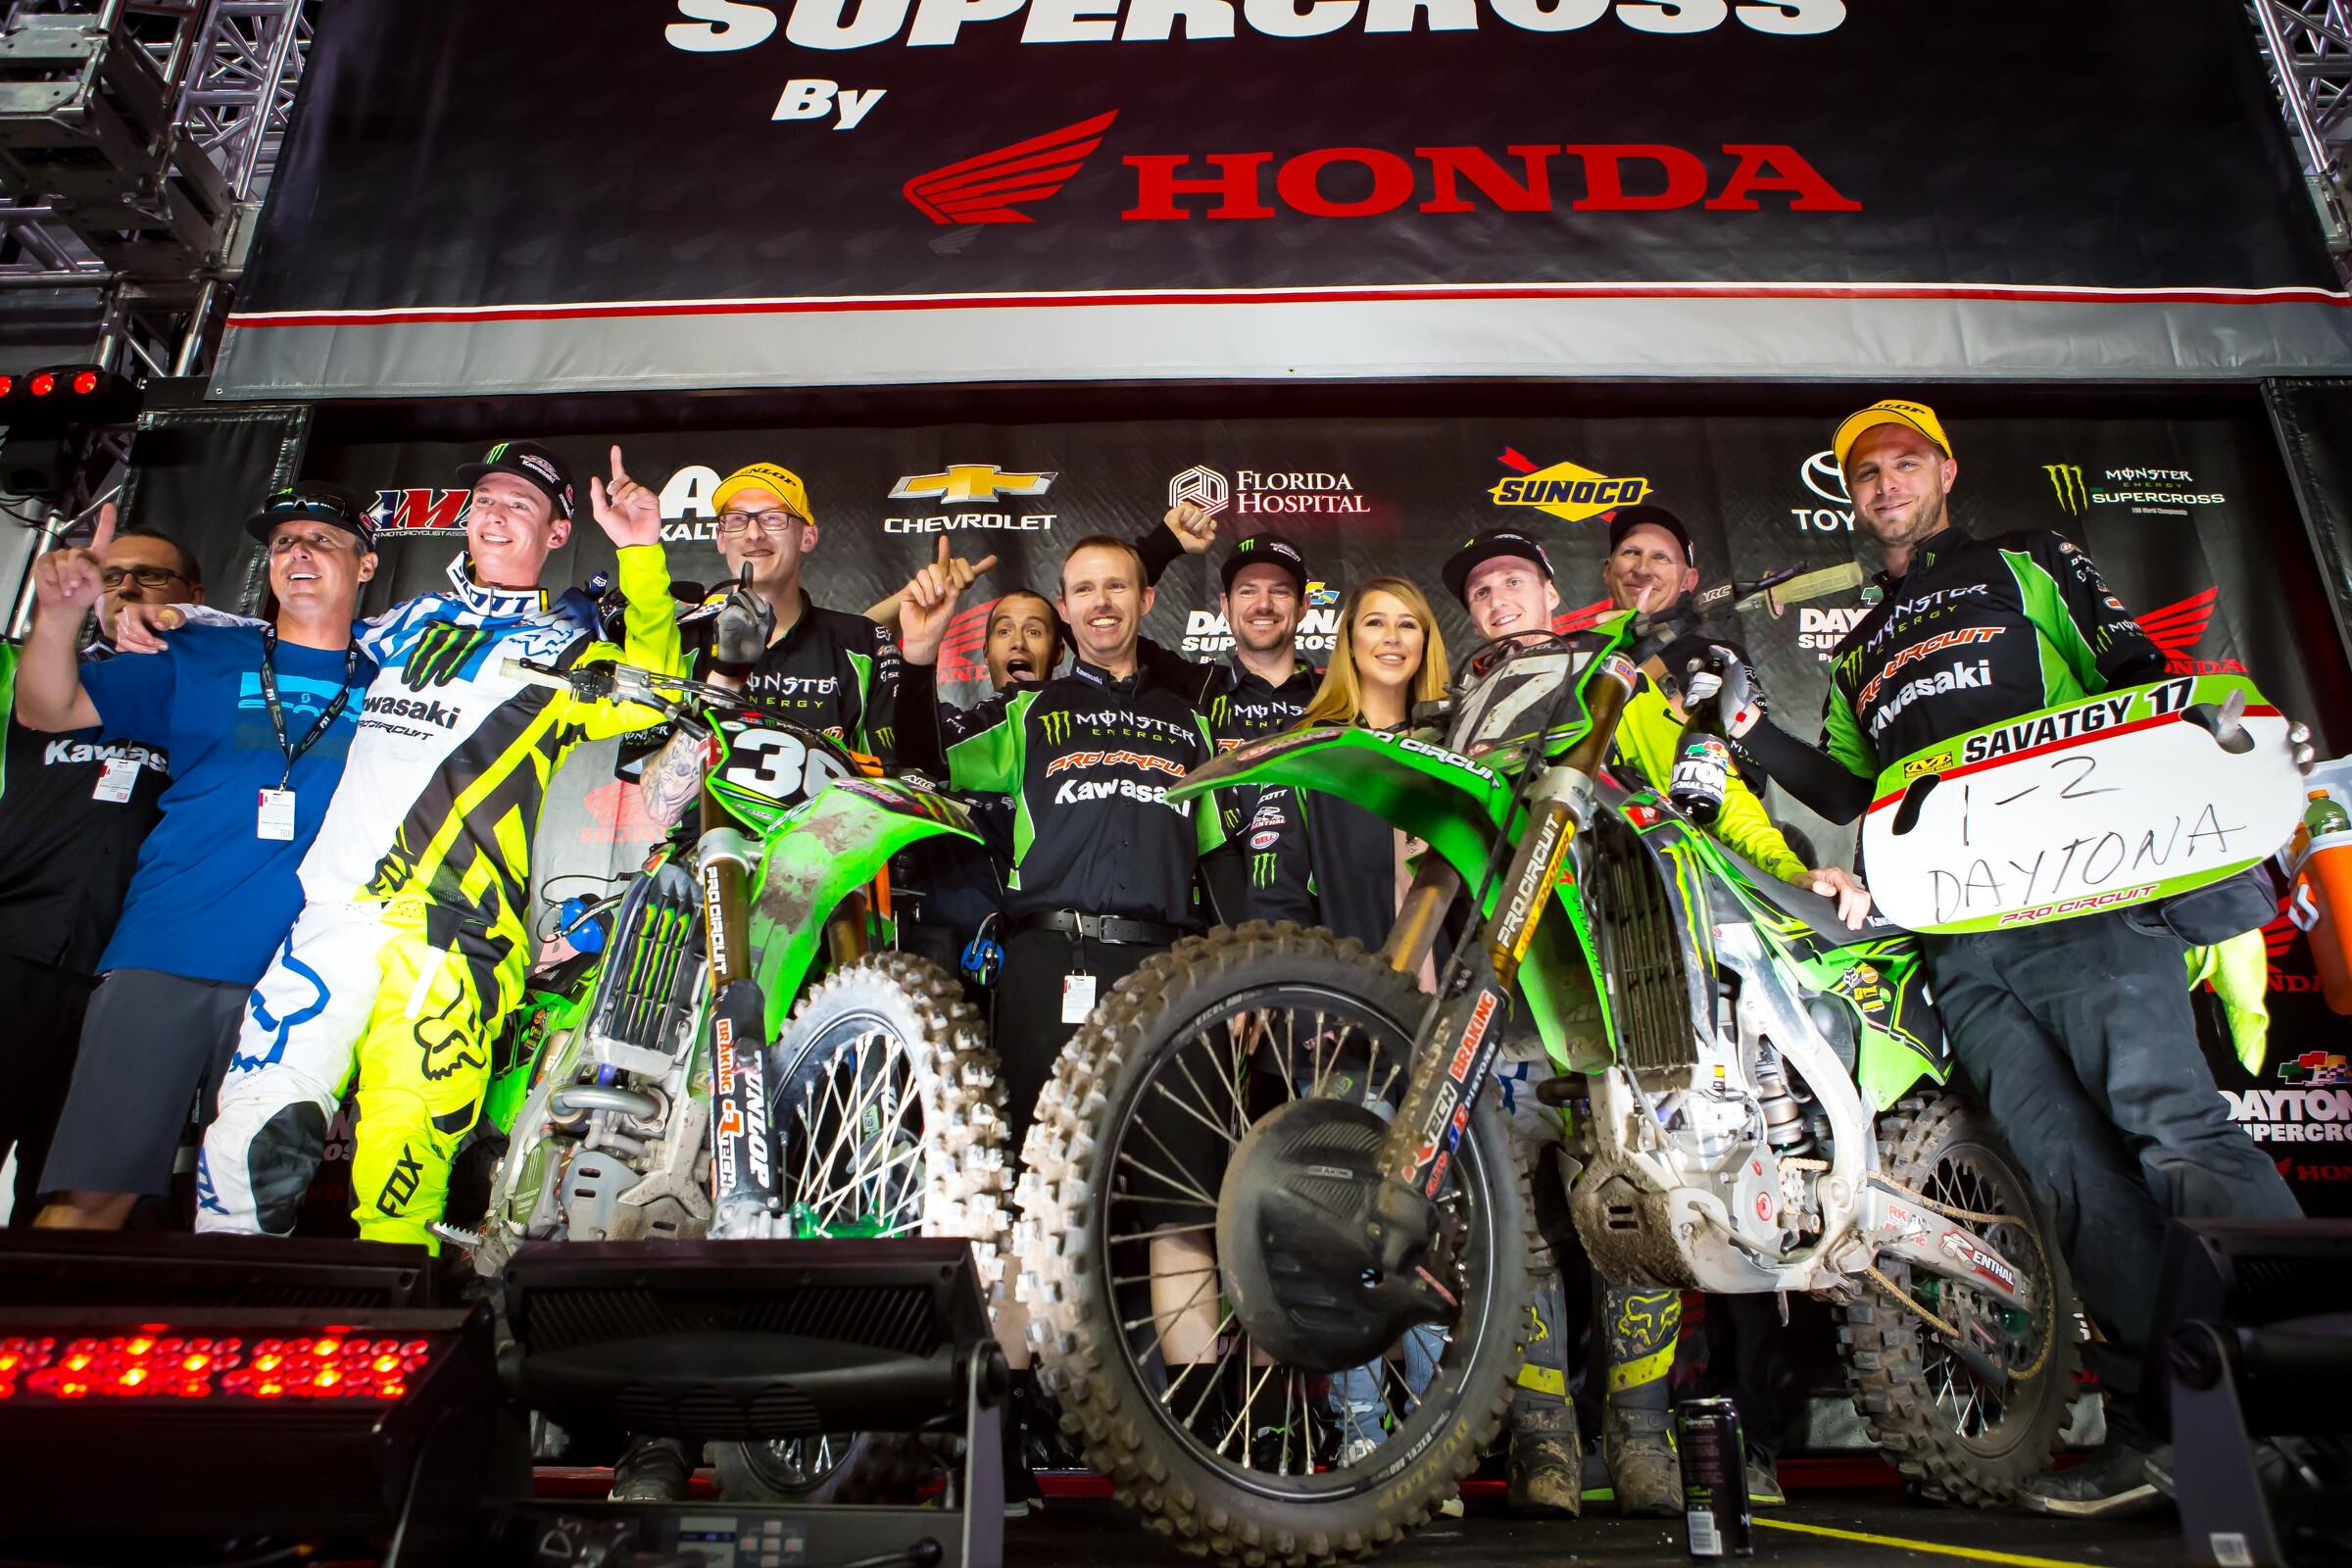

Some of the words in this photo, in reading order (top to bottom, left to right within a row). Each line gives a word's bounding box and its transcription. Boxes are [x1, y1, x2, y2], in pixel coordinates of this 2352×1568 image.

[664, 0, 1846, 52] SUPERCROSS
[772, 79, 886, 129] By
[1121, 144, 1862, 220] HONDA
[1237, 470, 1353, 491] FLORIDA
[1497, 480, 1645, 504] SUNOCO
[2105, 467, 2193, 482] MONSTER
[367, 488, 470, 531] AM
[1237, 492, 1371, 514] HOSPITAL
[2091, 492, 2226, 505] SUPERCROSS
[884, 514, 1057, 534] CHEVROLET
[1876, 605, 1958, 656] EERGY
[1882, 626, 2007, 679] CIRCUIT
[1075, 710, 1197, 748] MONSTER
[1092, 728, 1177, 745] ENERGY
[1962, 694, 2133, 764] SAVATGY
[2143, 676, 2198, 718] 17
[900, 773, 936, 791] ARC
[1045, 751, 1104, 778] PRO
[1254, 835, 1276, 846] BELL
[1495, 894, 1526, 950] PRO
[1517, 812, 1560, 901] CIRCUIT
[1928, 803, 2248, 924] DAYTONA
[706, 865, 719, 905] PRO
[1998, 904, 2055, 926] PRO
[2056, 884, 2161, 916] CIRCUIT
[708, 904, 729, 975] CIRCUIT
[717, 1019, 734, 1094] BRAKING
[1449, 991, 1496, 1082] BRAKING
[2240, 1123, 2352, 1142] PERCRO
[375, 1142, 424, 1218] FOX
[1887, 1203, 1908, 1223] RK
